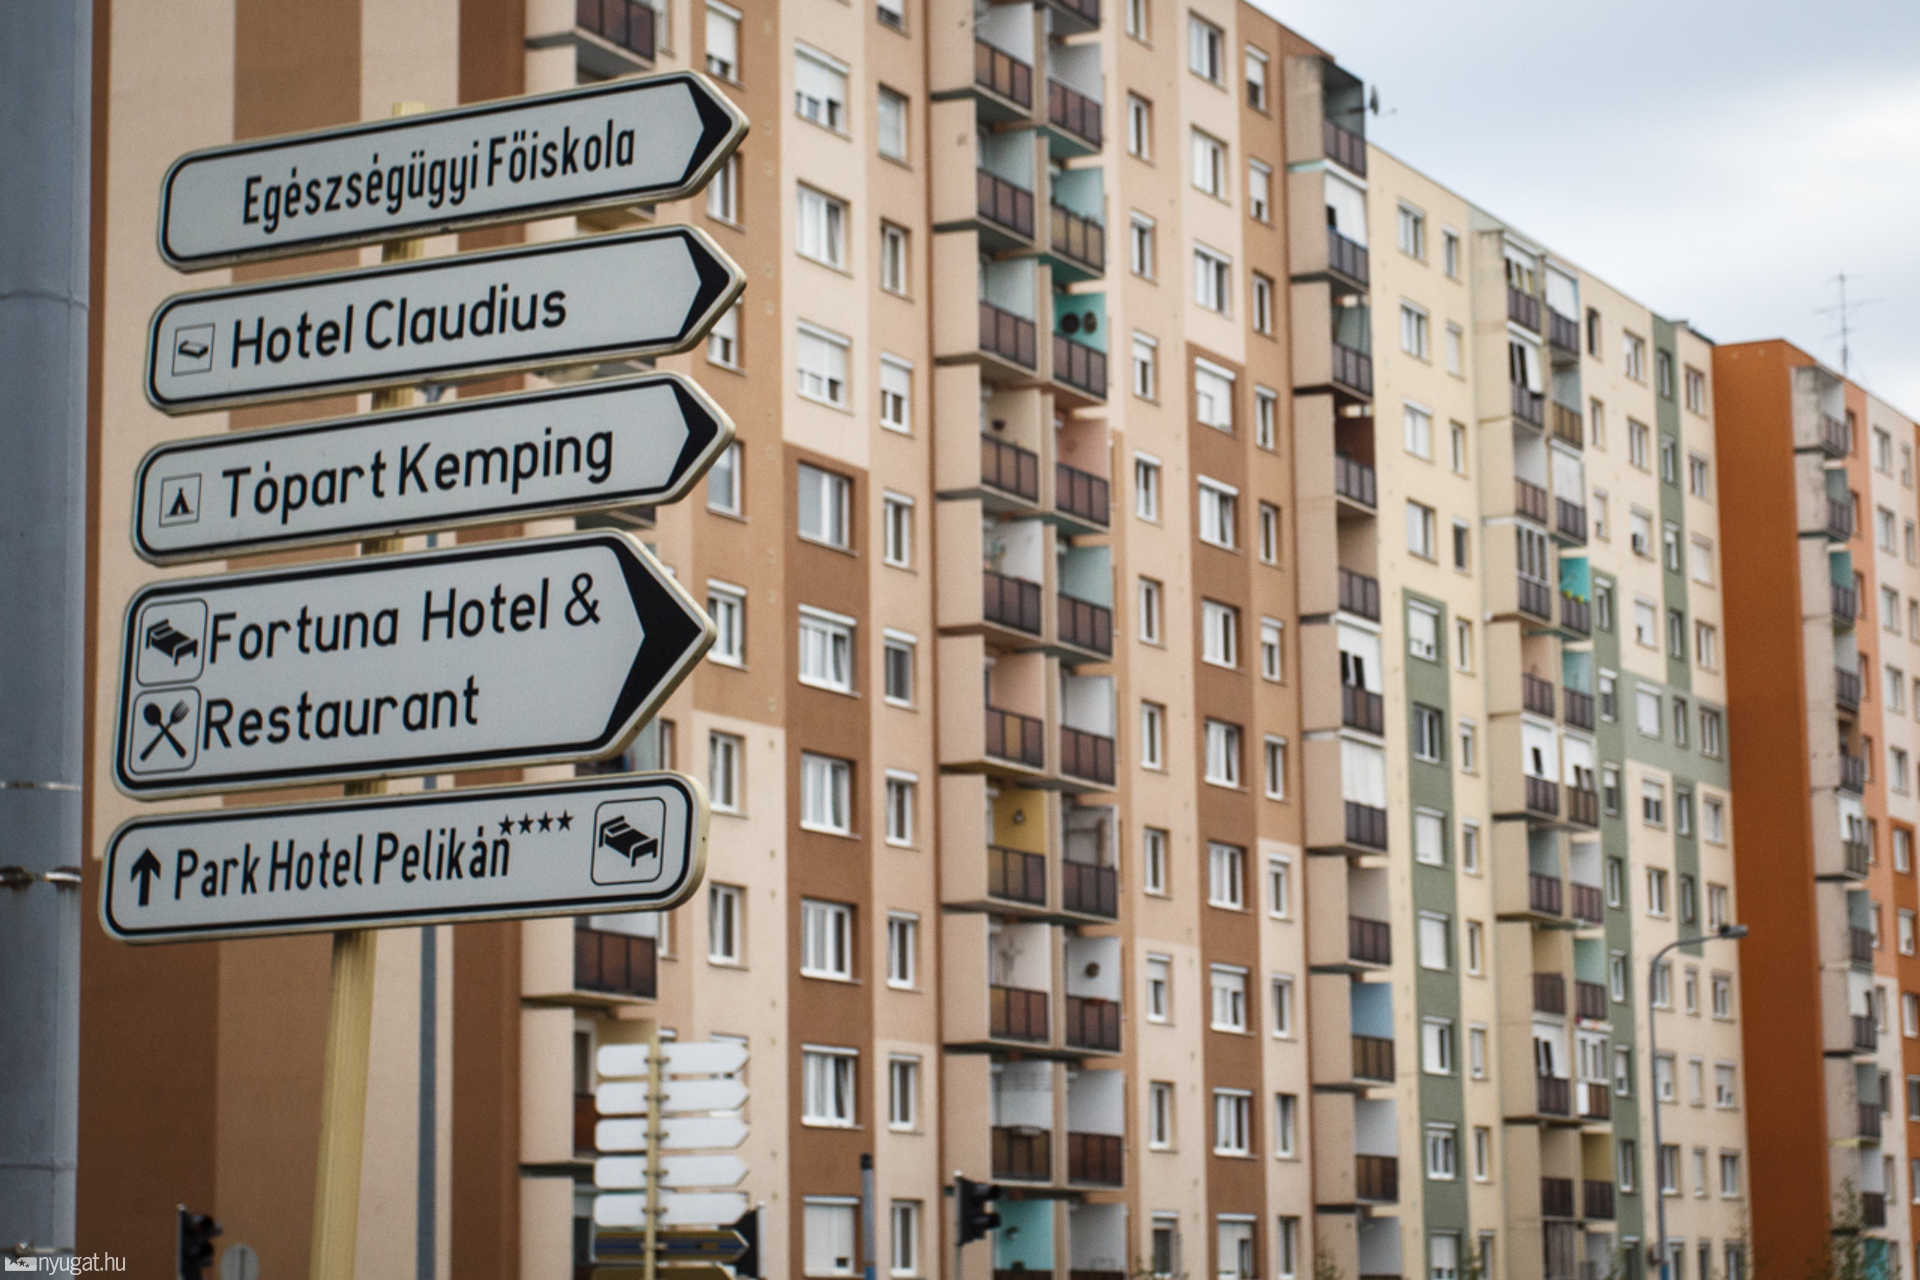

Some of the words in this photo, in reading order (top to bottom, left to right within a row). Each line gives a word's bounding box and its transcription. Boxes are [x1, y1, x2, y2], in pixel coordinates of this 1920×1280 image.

[242, 140, 479, 233] Egészségügyi
[231, 304, 354, 369] Hotel
[365, 283, 566, 350] Claudius
[221, 450, 387, 525] Tópart
[398, 427, 613, 496] Kemping
[209, 605, 399, 664] Fortuna
[422, 577, 549, 642] Hotel
[564, 572, 601, 627] &
[202, 675, 480, 751] Restaurant
[174, 843, 261, 901] Park
[268, 833, 364, 893] Hotel
[373, 825, 510, 885] Pelikán
